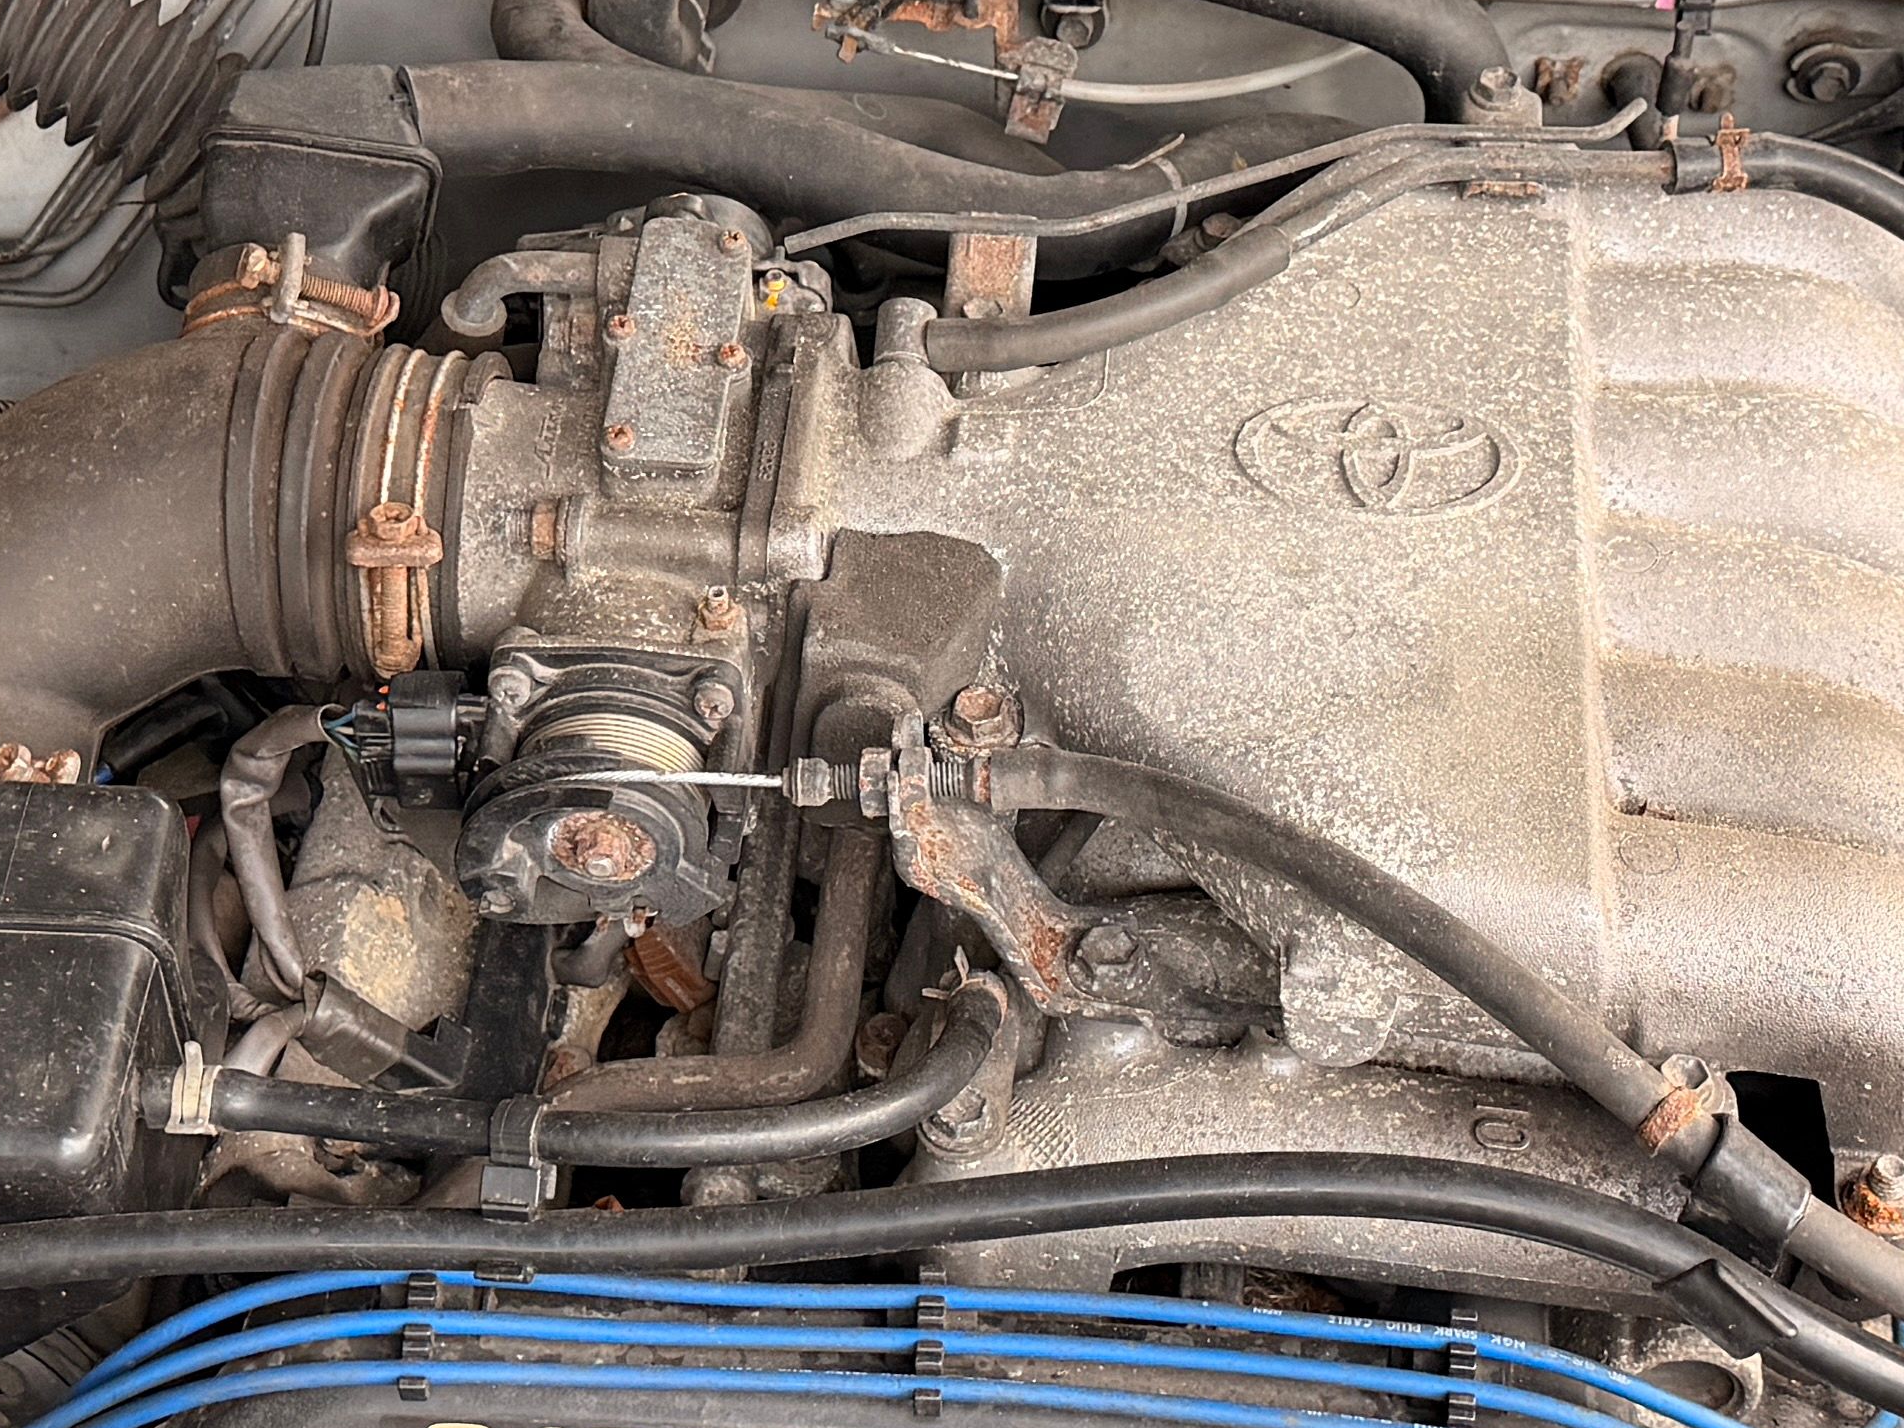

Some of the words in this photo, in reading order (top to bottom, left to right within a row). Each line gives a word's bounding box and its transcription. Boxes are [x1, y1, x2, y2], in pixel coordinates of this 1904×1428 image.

[1385, 1321, 1422, 1333] PLUG
[1434, 1326, 1478, 1340] SPARK
[1491, 1333, 1526, 1350] NGK
